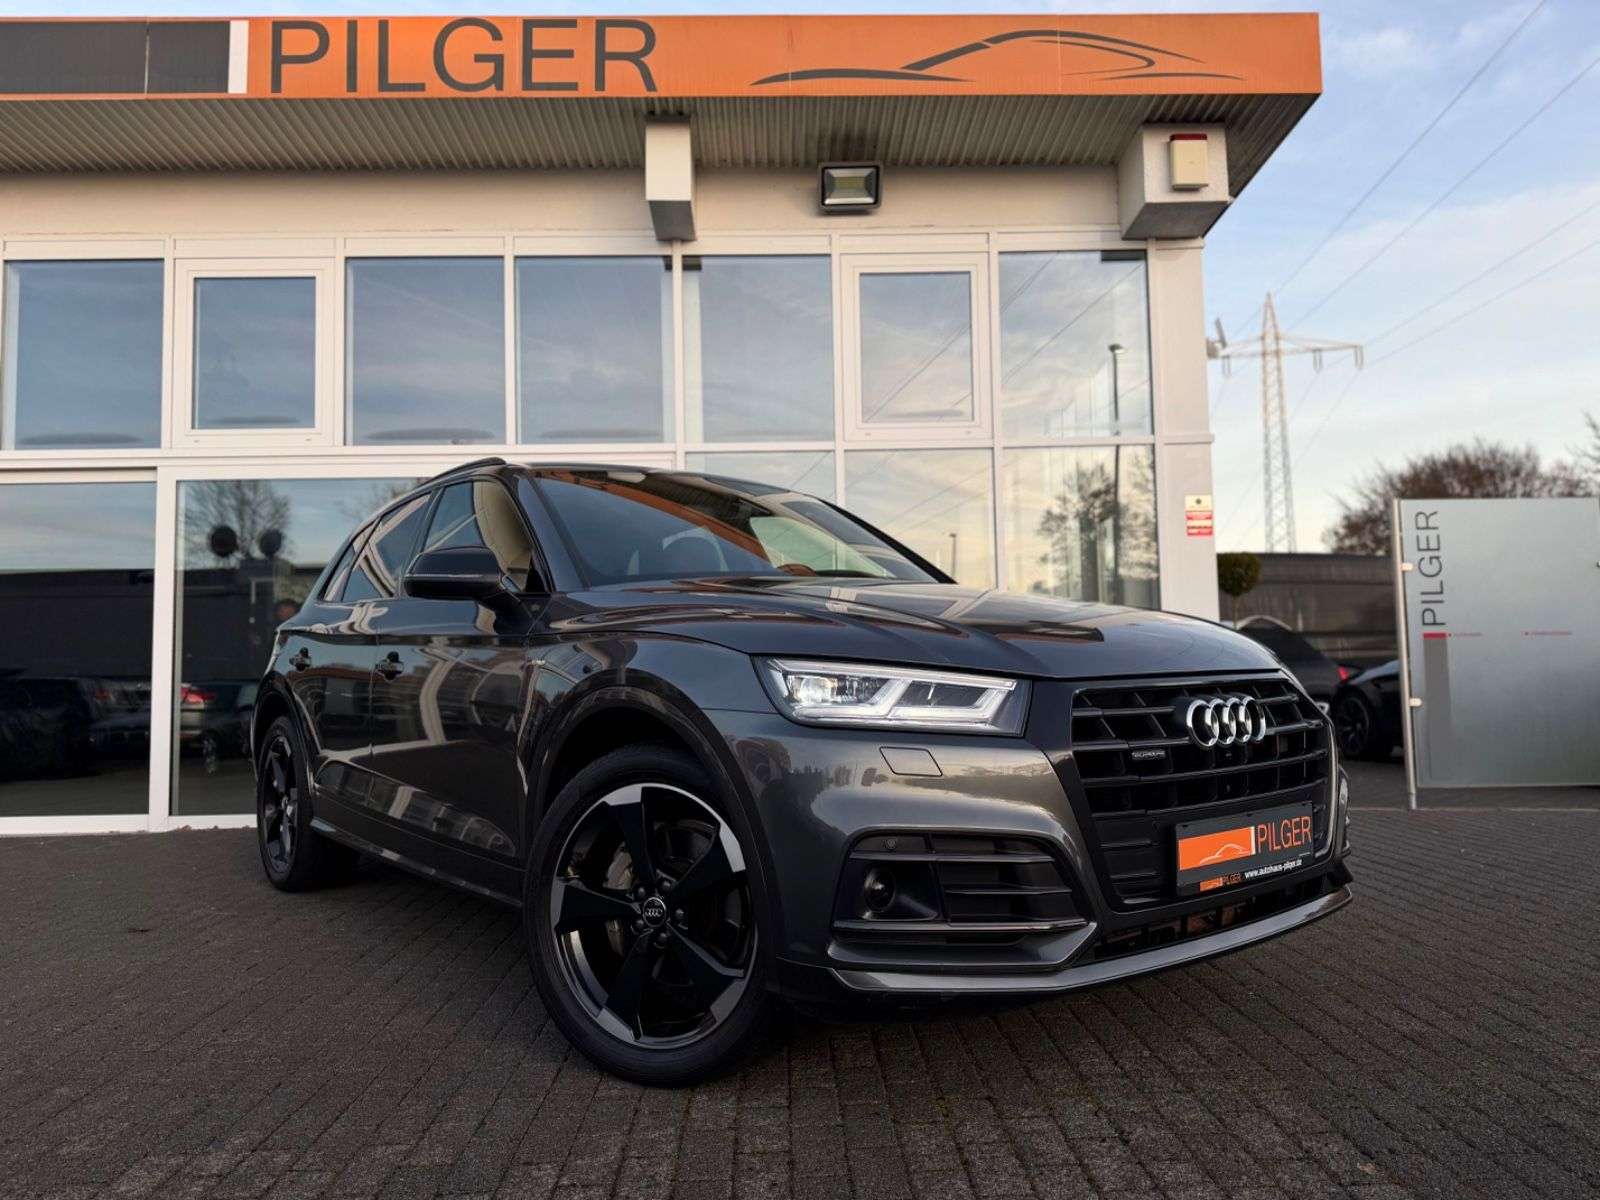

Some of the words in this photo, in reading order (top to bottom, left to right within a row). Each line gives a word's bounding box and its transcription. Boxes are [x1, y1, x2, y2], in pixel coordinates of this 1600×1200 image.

[270, 17, 658, 94] PILGER
[1415, 510, 1446, 626] PILGER
[1257, 816, 1312, 854] PILGER
